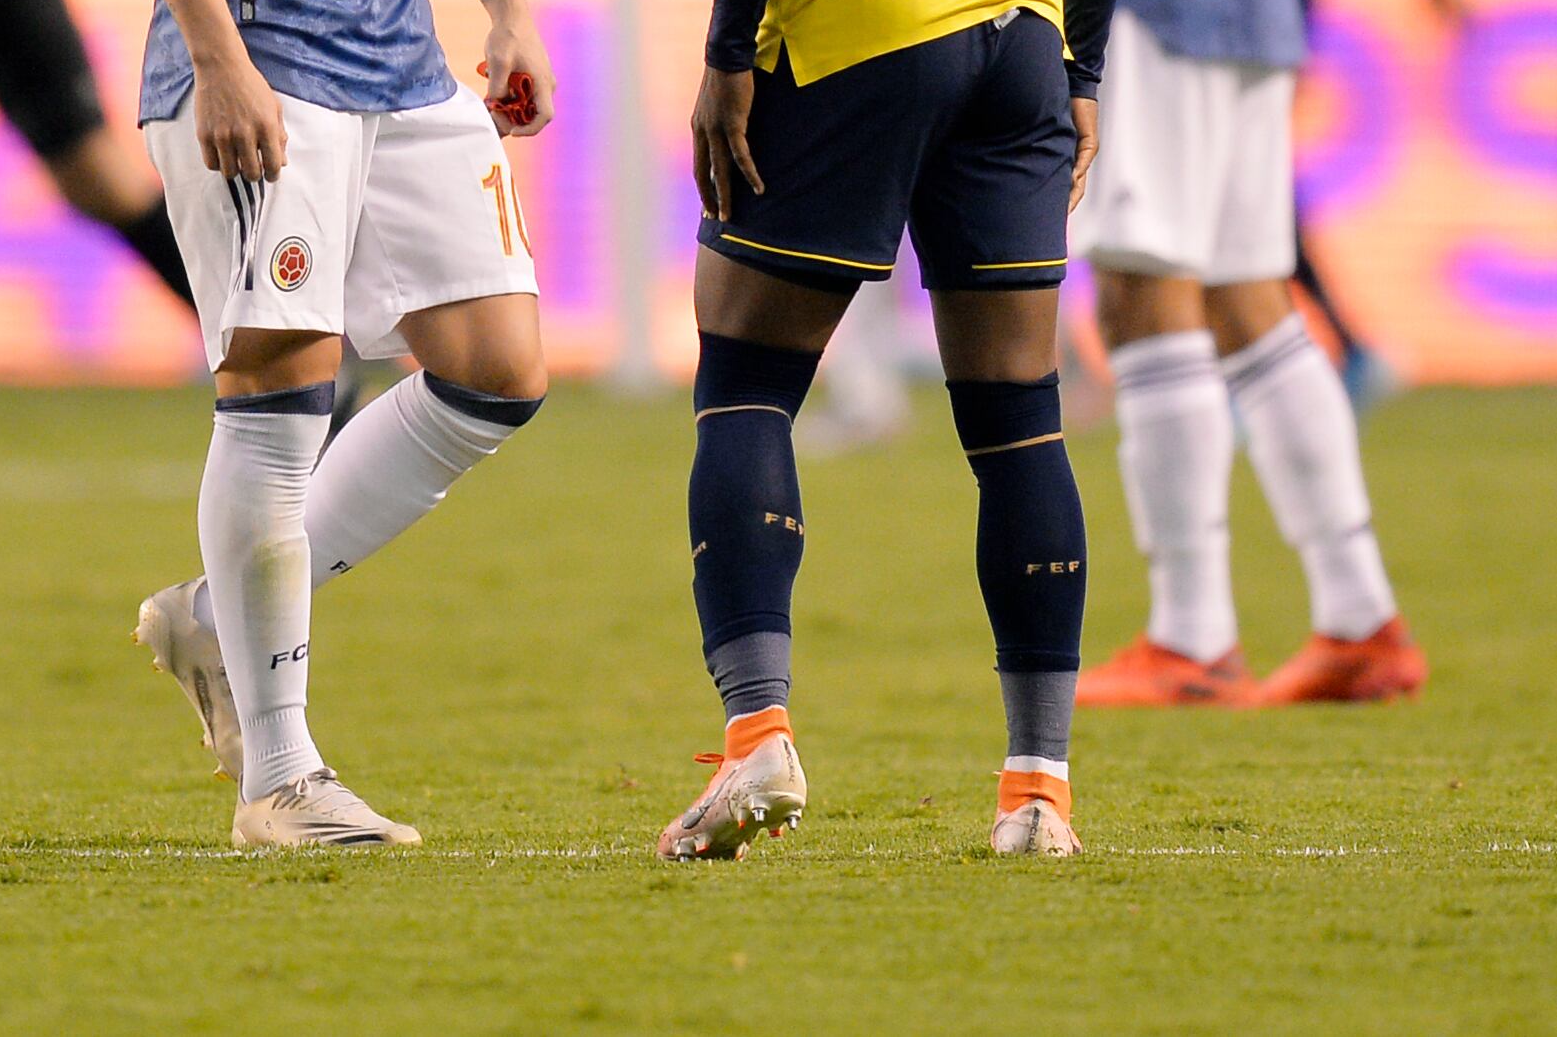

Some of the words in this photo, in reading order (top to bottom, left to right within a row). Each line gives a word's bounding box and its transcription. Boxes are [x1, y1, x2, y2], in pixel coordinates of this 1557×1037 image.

[482, 163, 533, 259] 1
[1026, 560, 1080, 576] FEF
[270, 639, 310, 671] FC
